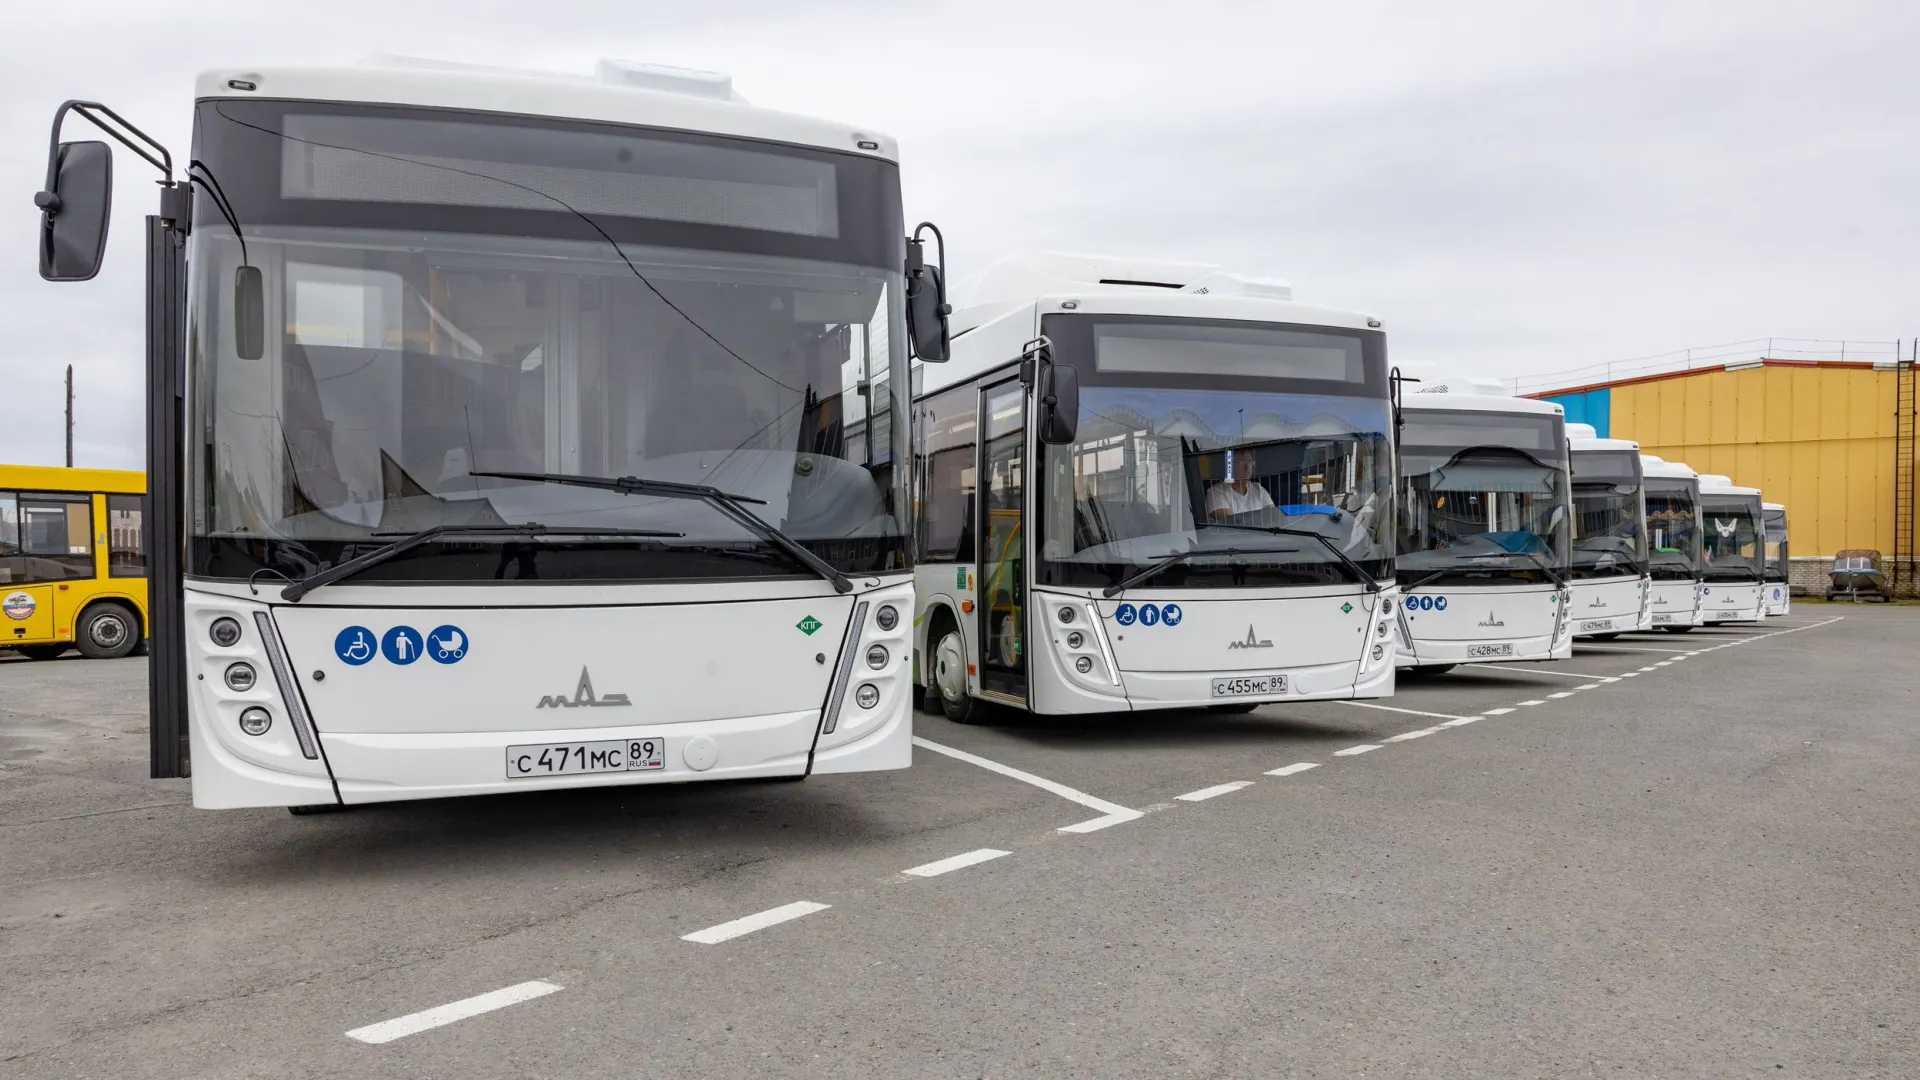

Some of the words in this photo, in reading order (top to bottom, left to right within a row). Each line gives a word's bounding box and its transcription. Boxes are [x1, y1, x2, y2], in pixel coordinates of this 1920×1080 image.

[800, 621, 818, 630] КПГ
[1270, 677, 1283, 688] 89
[517, 746, 622, 773] С471МС
[630, 741, 655, 760] 89
[629, 759, 648, 768] RUS
